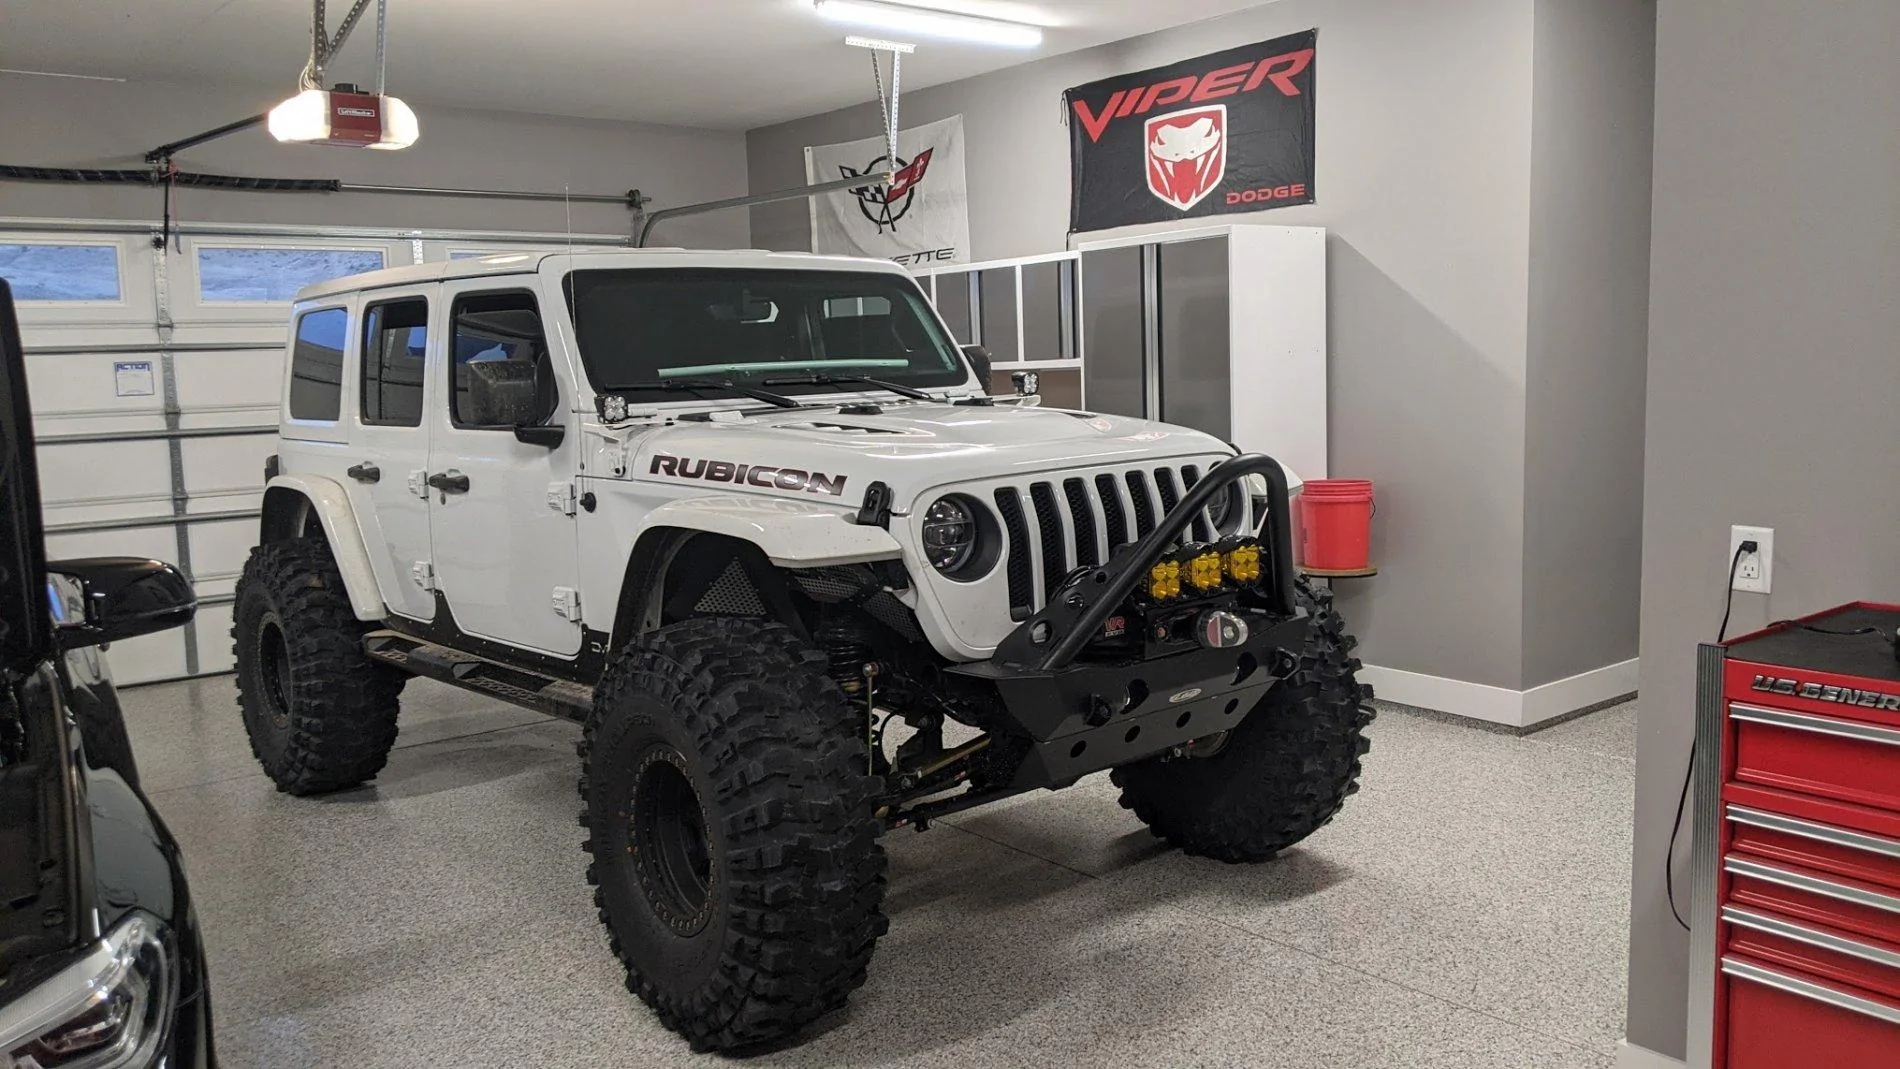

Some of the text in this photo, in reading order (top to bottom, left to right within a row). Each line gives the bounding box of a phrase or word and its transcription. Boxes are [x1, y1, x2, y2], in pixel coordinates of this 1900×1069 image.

[1073, 49, 1314, 143] VIPER
[1226, 184, 1305, 205] DODGE
[889, 247, 955, 266] ETTE
[649, 454, 848, 496] RUBICON
